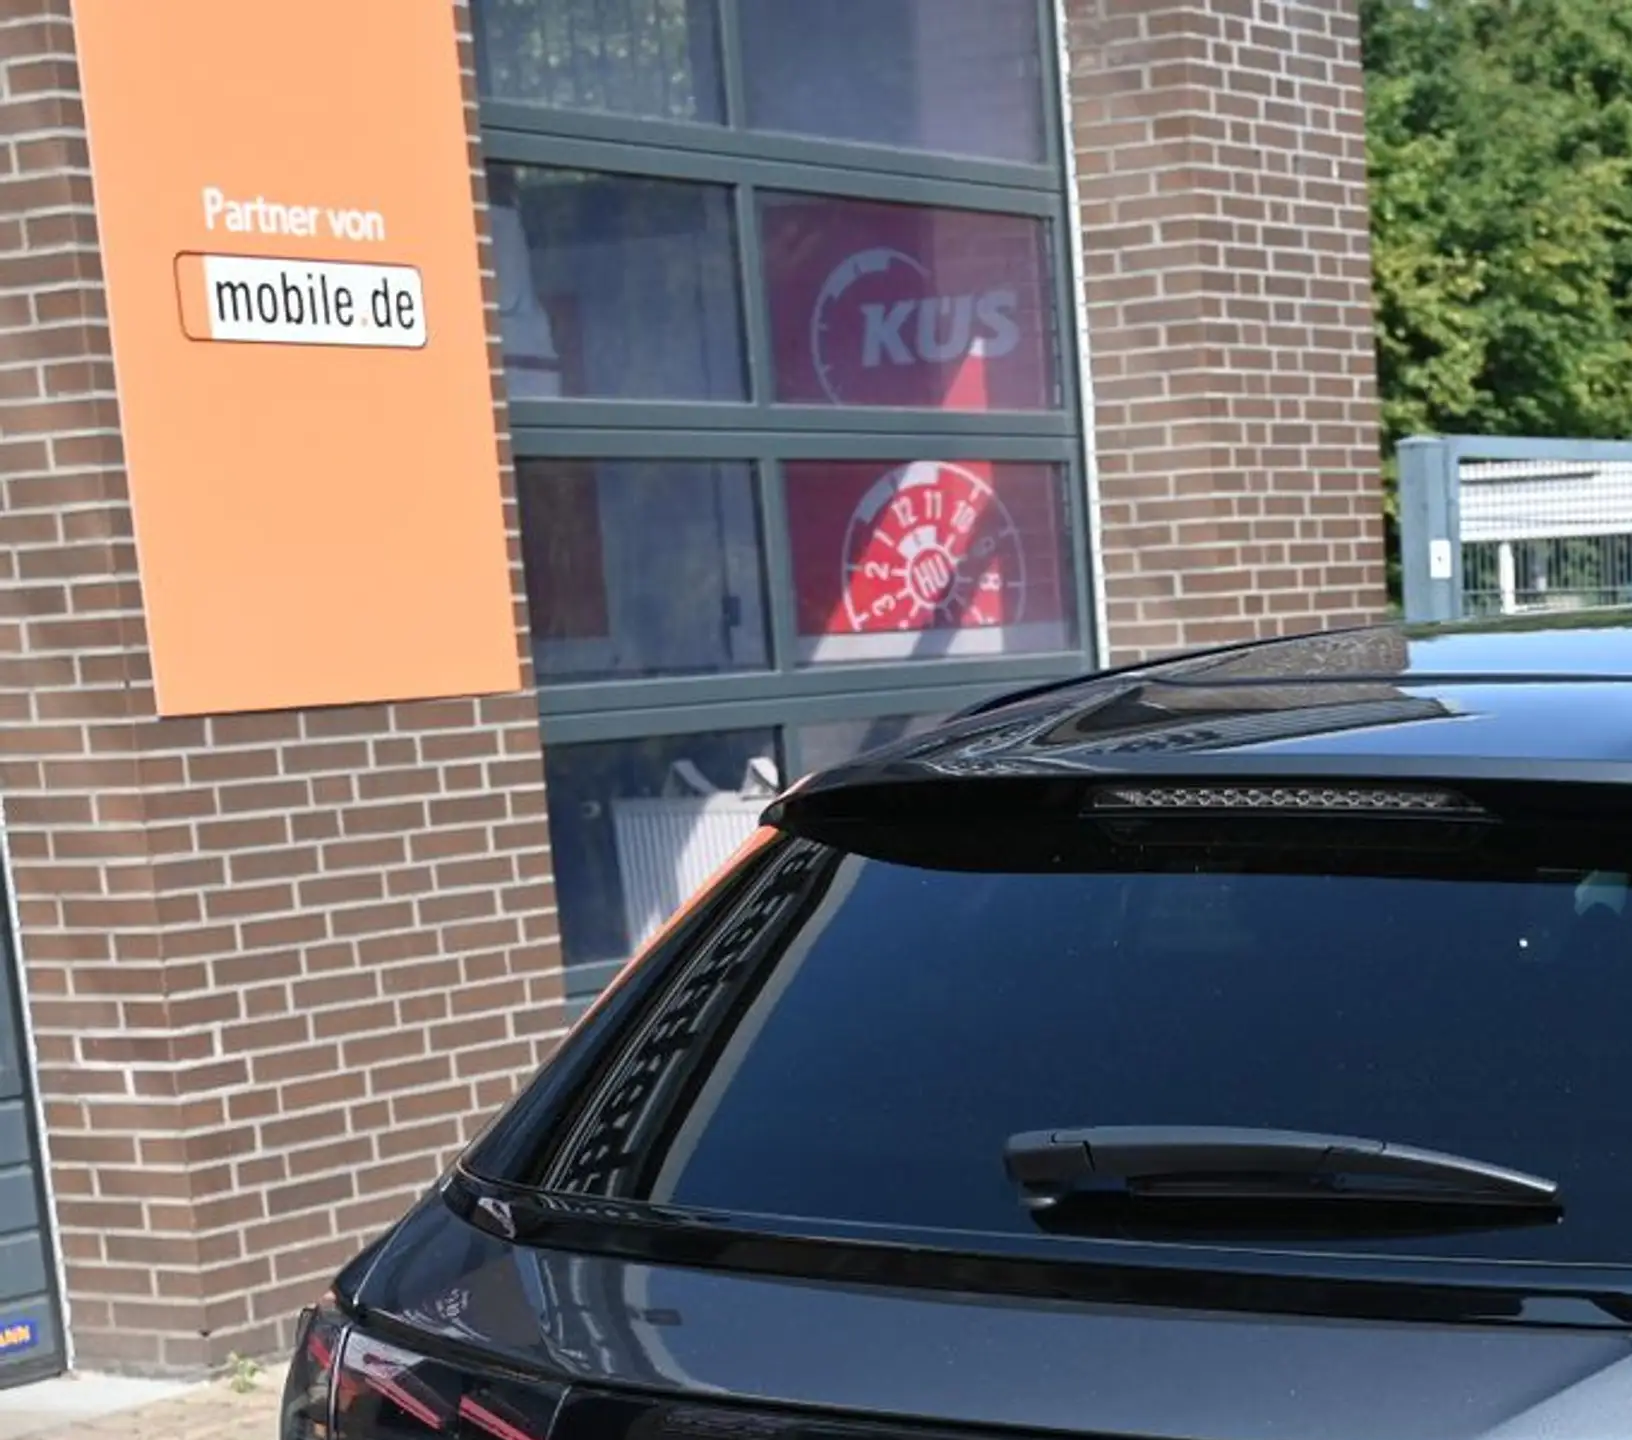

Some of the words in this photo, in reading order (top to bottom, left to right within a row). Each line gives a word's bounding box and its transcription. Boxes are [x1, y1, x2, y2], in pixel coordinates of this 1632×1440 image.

[203, 186, 319, 238] Partner
[326, 208, 386, 242] von
[215, 271, 416, 330] mobile.de
[891, 496, 918, 528] 12
[923, 490, 943, 520] 11
[864, 561, 889, 581] 2
[914, 553, 949, 599] HU
[872, 593, 897, 617] 3
